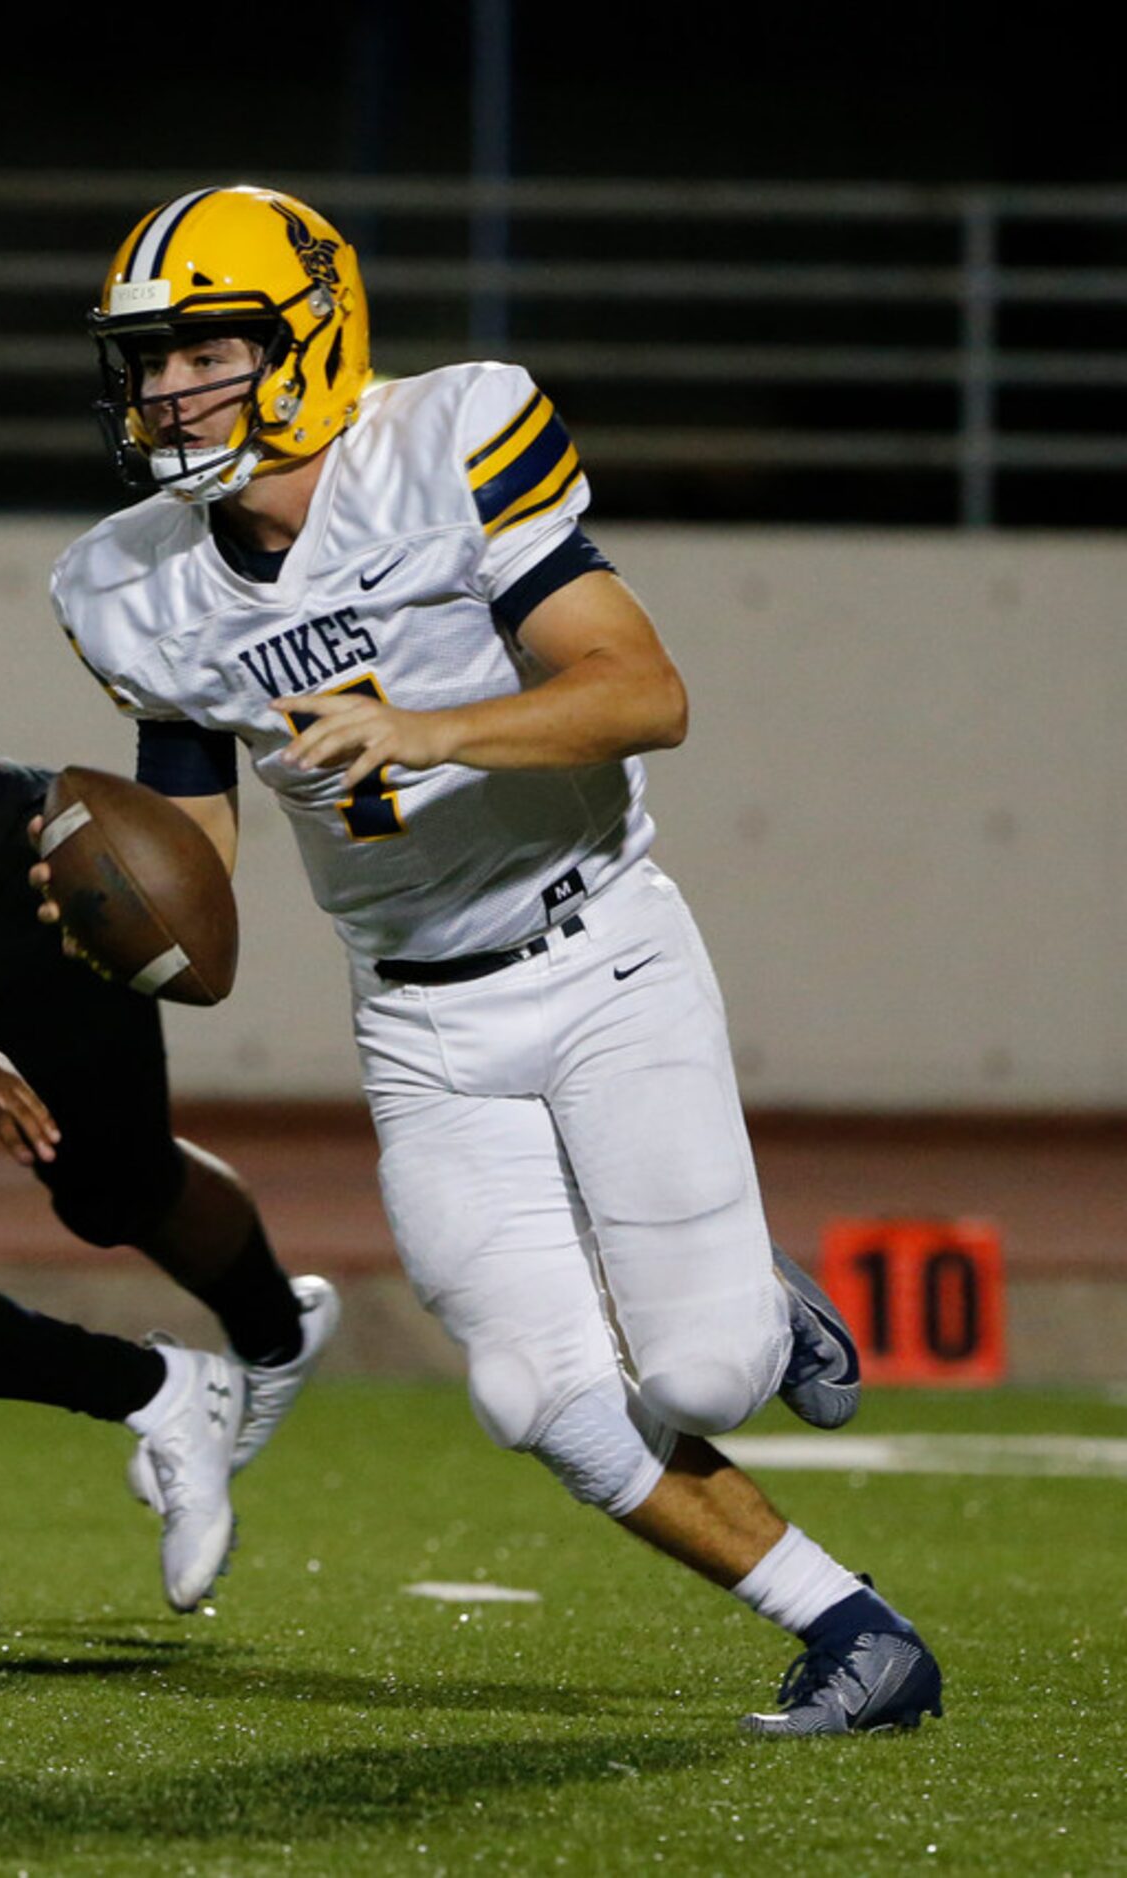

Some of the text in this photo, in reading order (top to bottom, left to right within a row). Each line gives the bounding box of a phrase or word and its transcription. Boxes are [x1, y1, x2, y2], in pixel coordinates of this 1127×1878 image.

[238, 606, 378, 699] VIKES
[554, 880, 572, 900] M
[853, 1249, 981, 1361] 10
